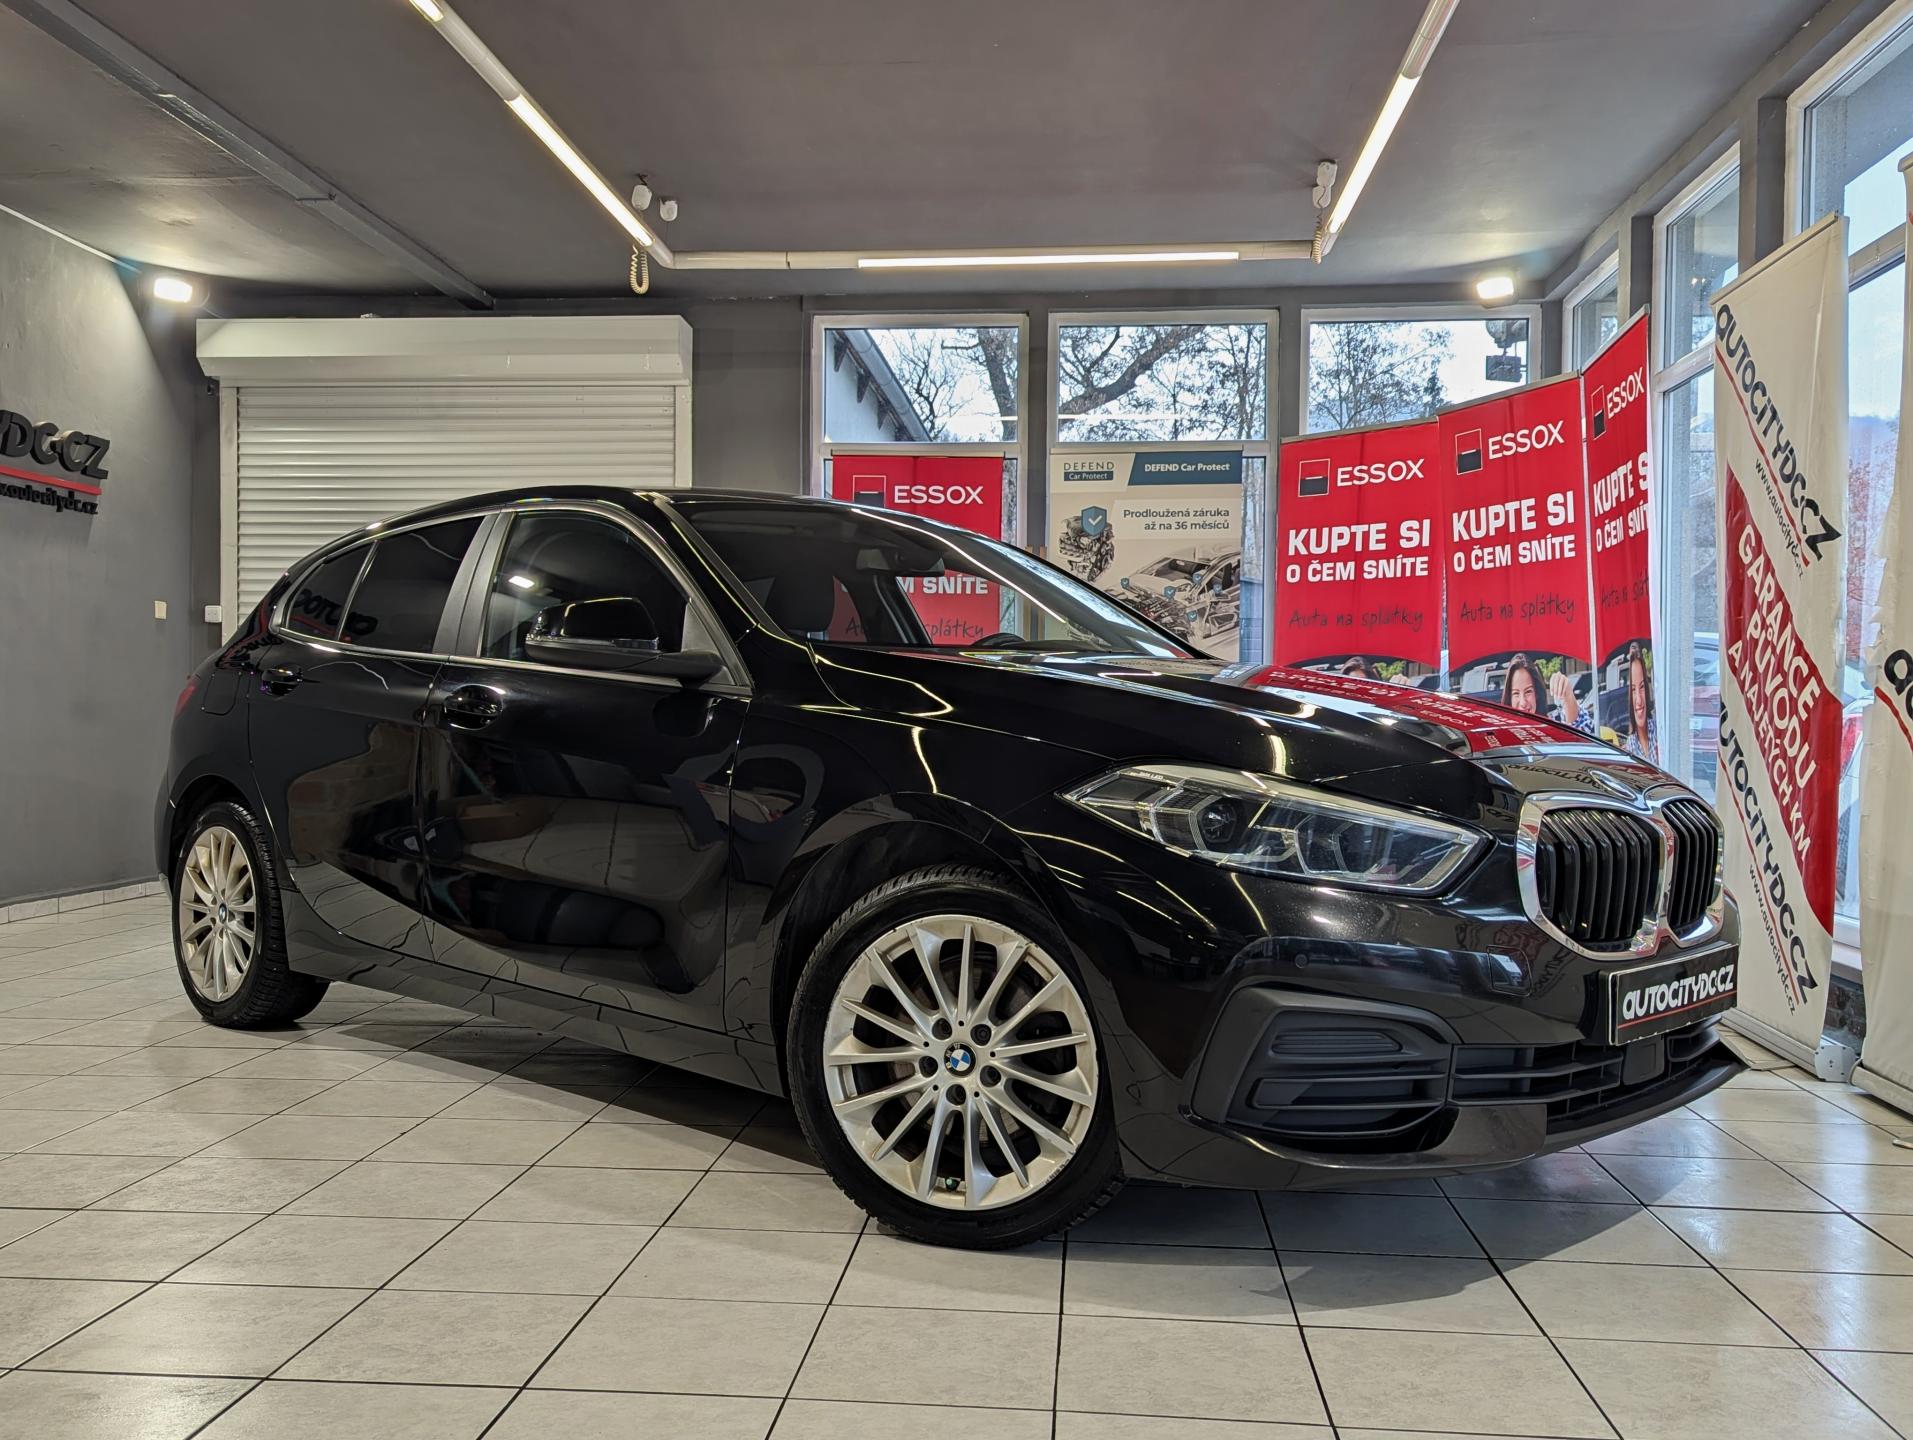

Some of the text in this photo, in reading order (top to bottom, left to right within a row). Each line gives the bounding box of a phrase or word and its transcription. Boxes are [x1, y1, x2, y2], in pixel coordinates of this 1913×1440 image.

[1607, 367, 1645, 419] ESSOX
[1488, 420, 1565, 459] ESSOX
[1063, 461, 1114, 471] DEFEND
[1144, 462, 1230, 472] DEFEND Car Protect
[1336, 458, 1425, 486] ESSOX
[893, 485, 984, 505] ESSOX
[1593, 451, 1648, 518] KUPTE S
[1123, 507, 1230, 518] Prodloužená záruka
[1144, 521, 1157, 530] až
[1174, 521, 1188, 530] 36
[1190, 519, 1230, 530] měsíců
[1452, 490, 1575, 542] KUPTE SI
[1596, 499, 1649, 552] O ČEM SNÍT
[1288, 519, 1431, 556] KUPTE SI
[1453, 533, 1576, 573] O ČEM SNÍTE
[923, 574, 989, 595] SNÍTE
[1286, 554, 1429, 583] O ČEM SNÍTE
[1289, 604, 1423, 632] Auta na splátky
[1460, 594, 1576, 624] Auta na splátky
[1738, 524, 1821, 721] GARANCE
[1747, 608, 1817, 789] PŮVODU
[1790, 801, 1811, 861] KM
